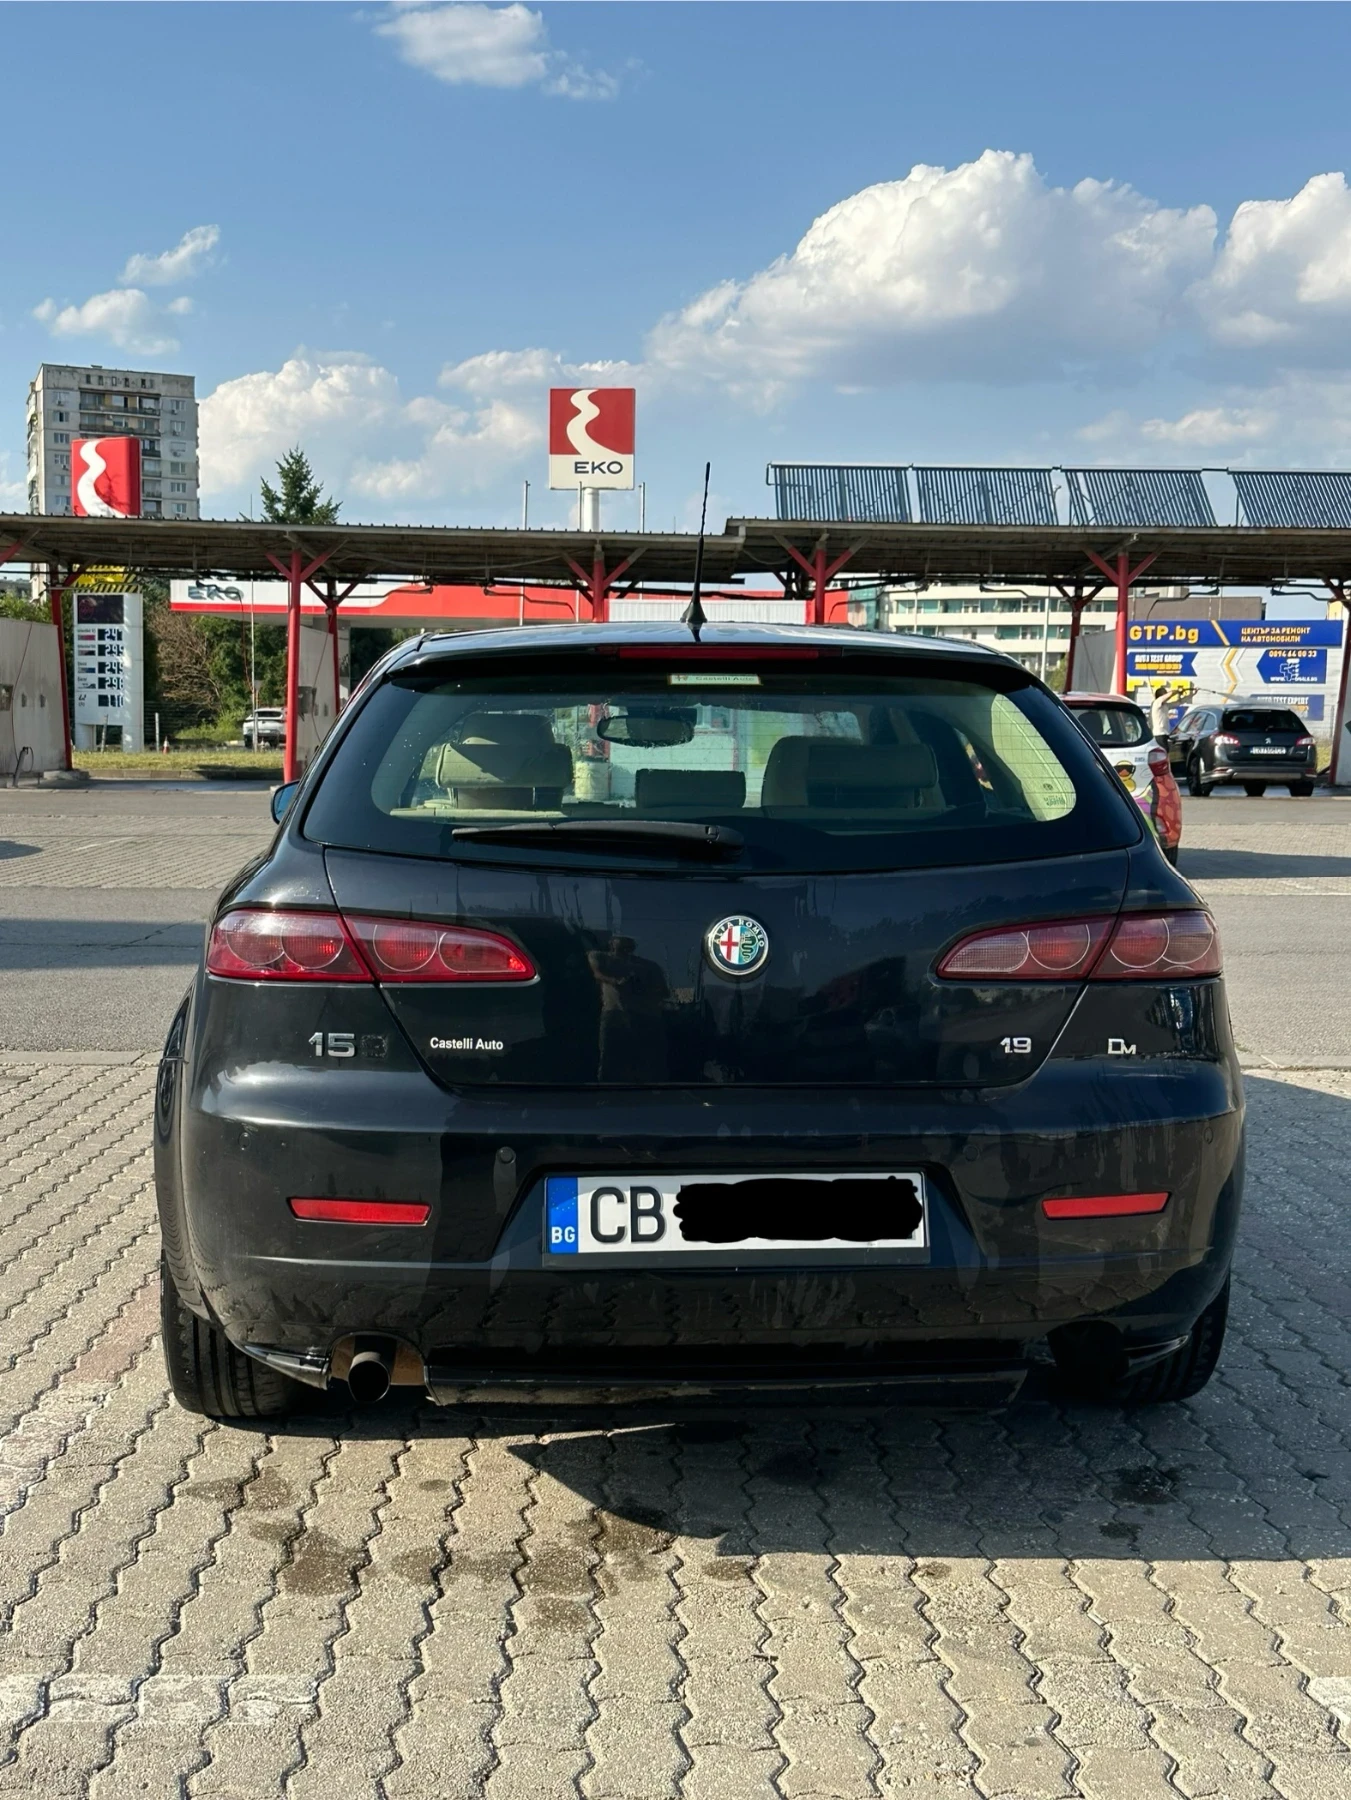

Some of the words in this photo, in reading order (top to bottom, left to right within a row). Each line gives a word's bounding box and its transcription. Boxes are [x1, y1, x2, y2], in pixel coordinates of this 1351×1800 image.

[574, 461, 623, 474] EKO
[1129, 625, 1199, 644] GTP.bg
[1241, 627, 1270, 635] ЦЕНТЪР
[430, 1037, 473, 1049] Castelli
[475, 1038, 504, 1050] Auto
[590, 1185, 666, 1244] CB
[551, 1226, 576, 1244] BG
